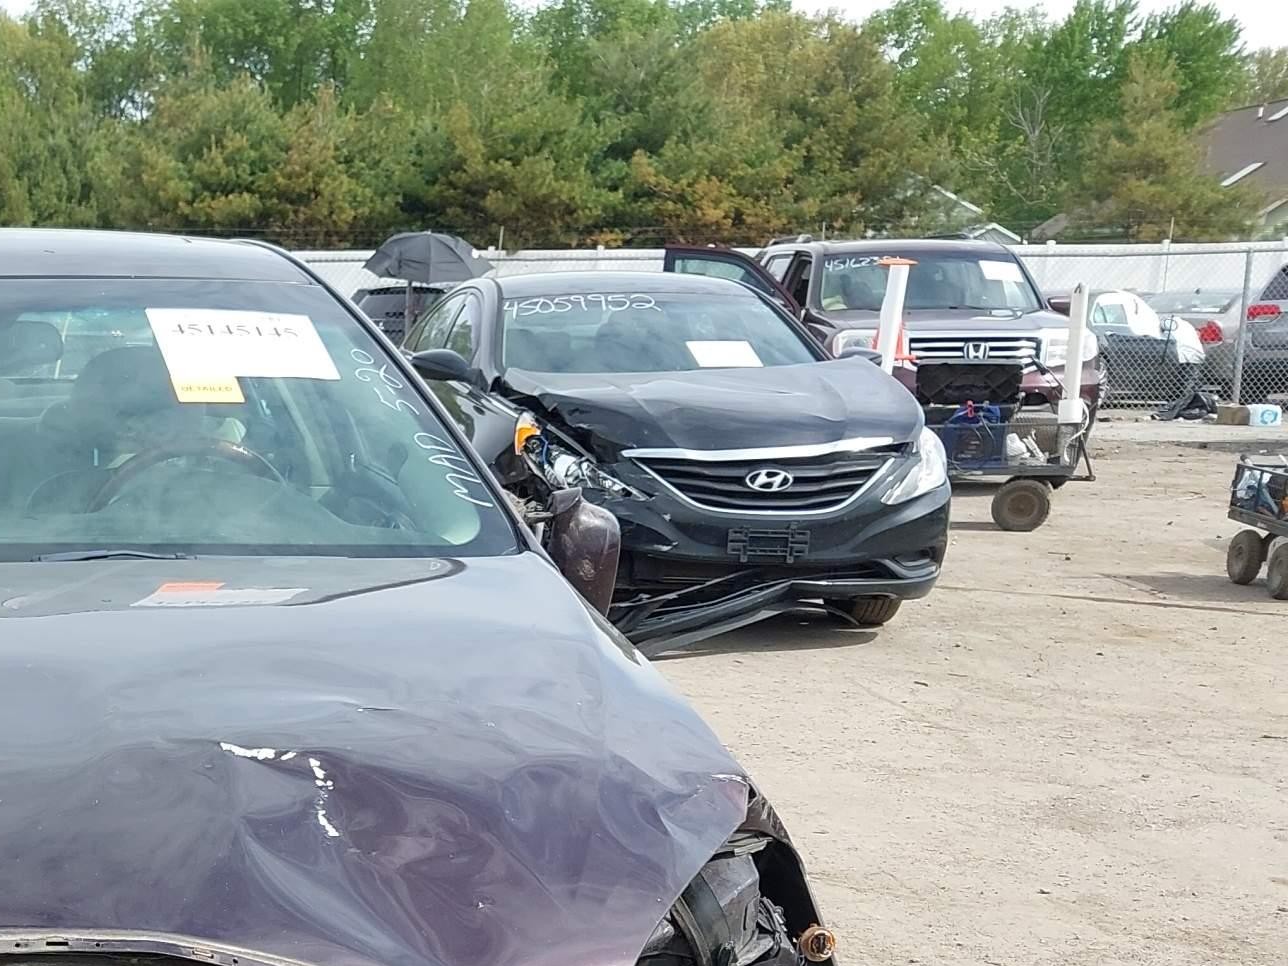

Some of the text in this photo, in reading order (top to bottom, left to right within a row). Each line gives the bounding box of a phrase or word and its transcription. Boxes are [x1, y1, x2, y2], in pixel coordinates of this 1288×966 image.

[503, 294, 662, 320] 45059952
[172, 323, 299, 338] 45145145
[350, 348, 420, 415] 5-20
